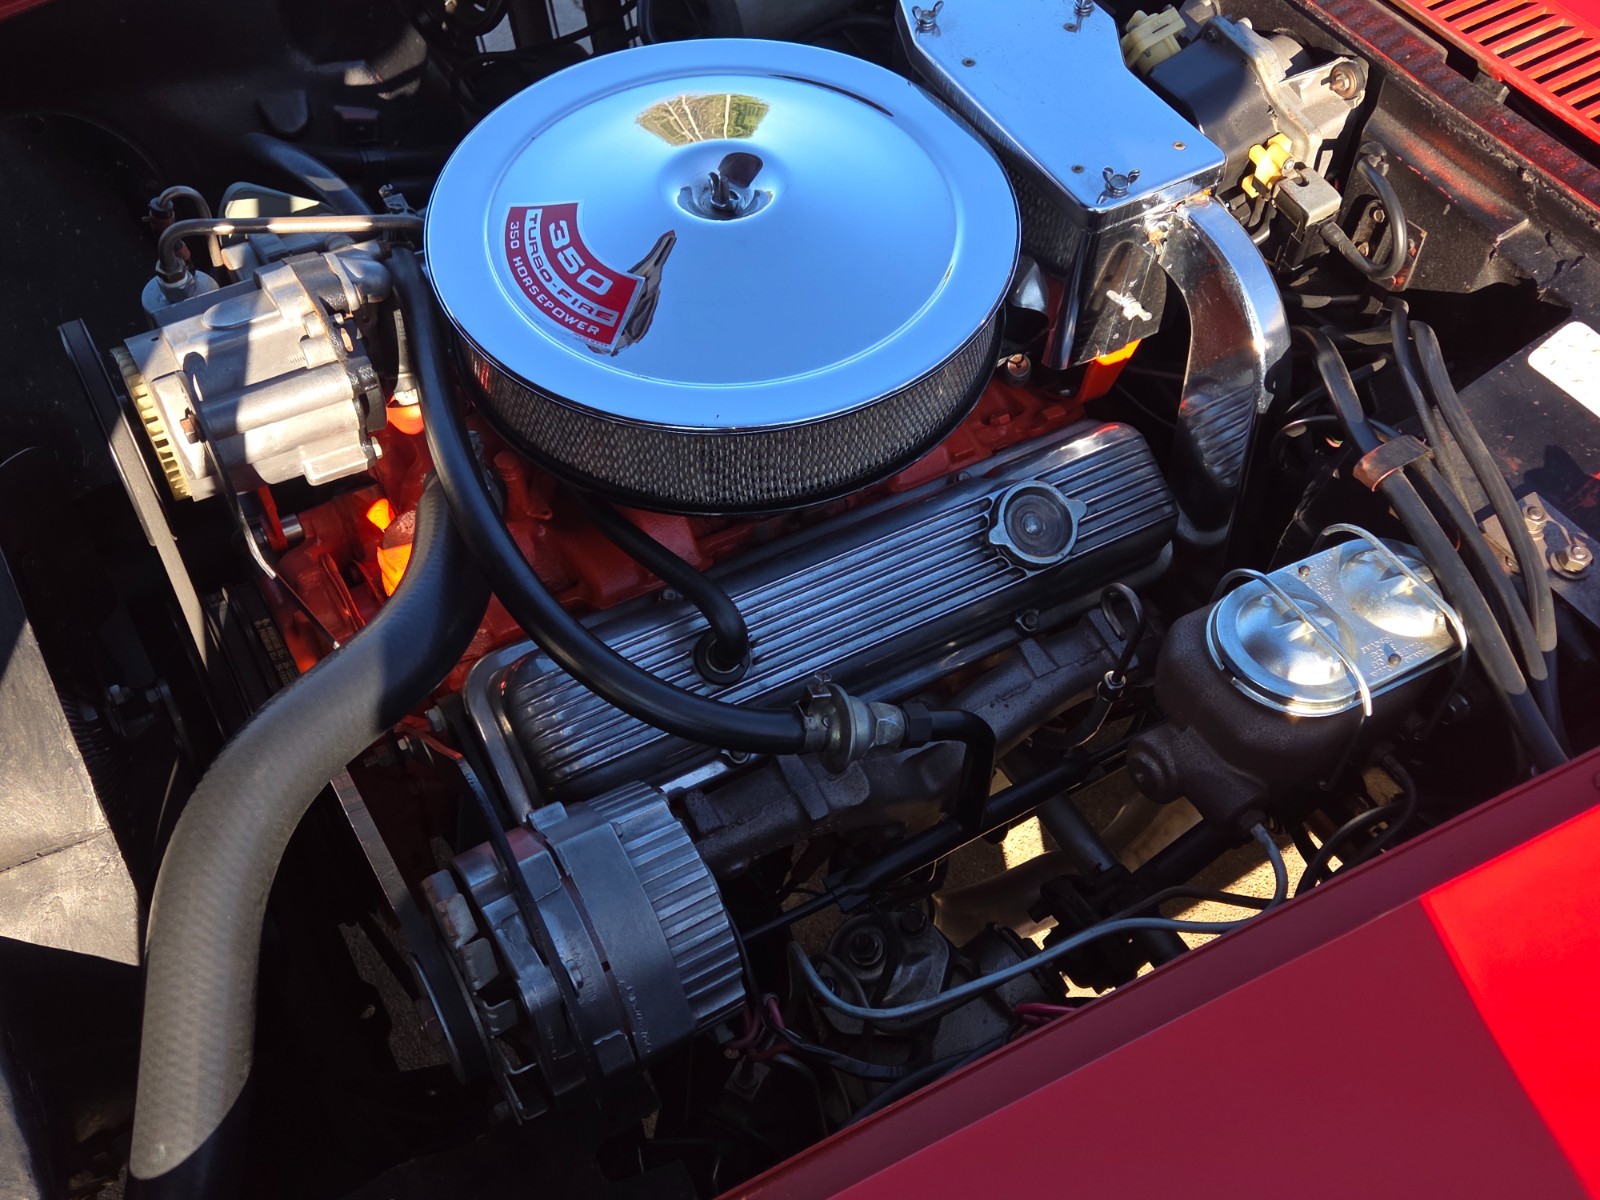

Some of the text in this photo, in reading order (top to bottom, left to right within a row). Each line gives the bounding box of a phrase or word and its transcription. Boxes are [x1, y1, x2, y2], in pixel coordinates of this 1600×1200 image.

[509, 221, 520, 249] 350
[528, 213, 614, 322] TURBO-FIRE
[548, 219, 613, 296] 350
[512, 256, 600, 335] HORSEPOWER
